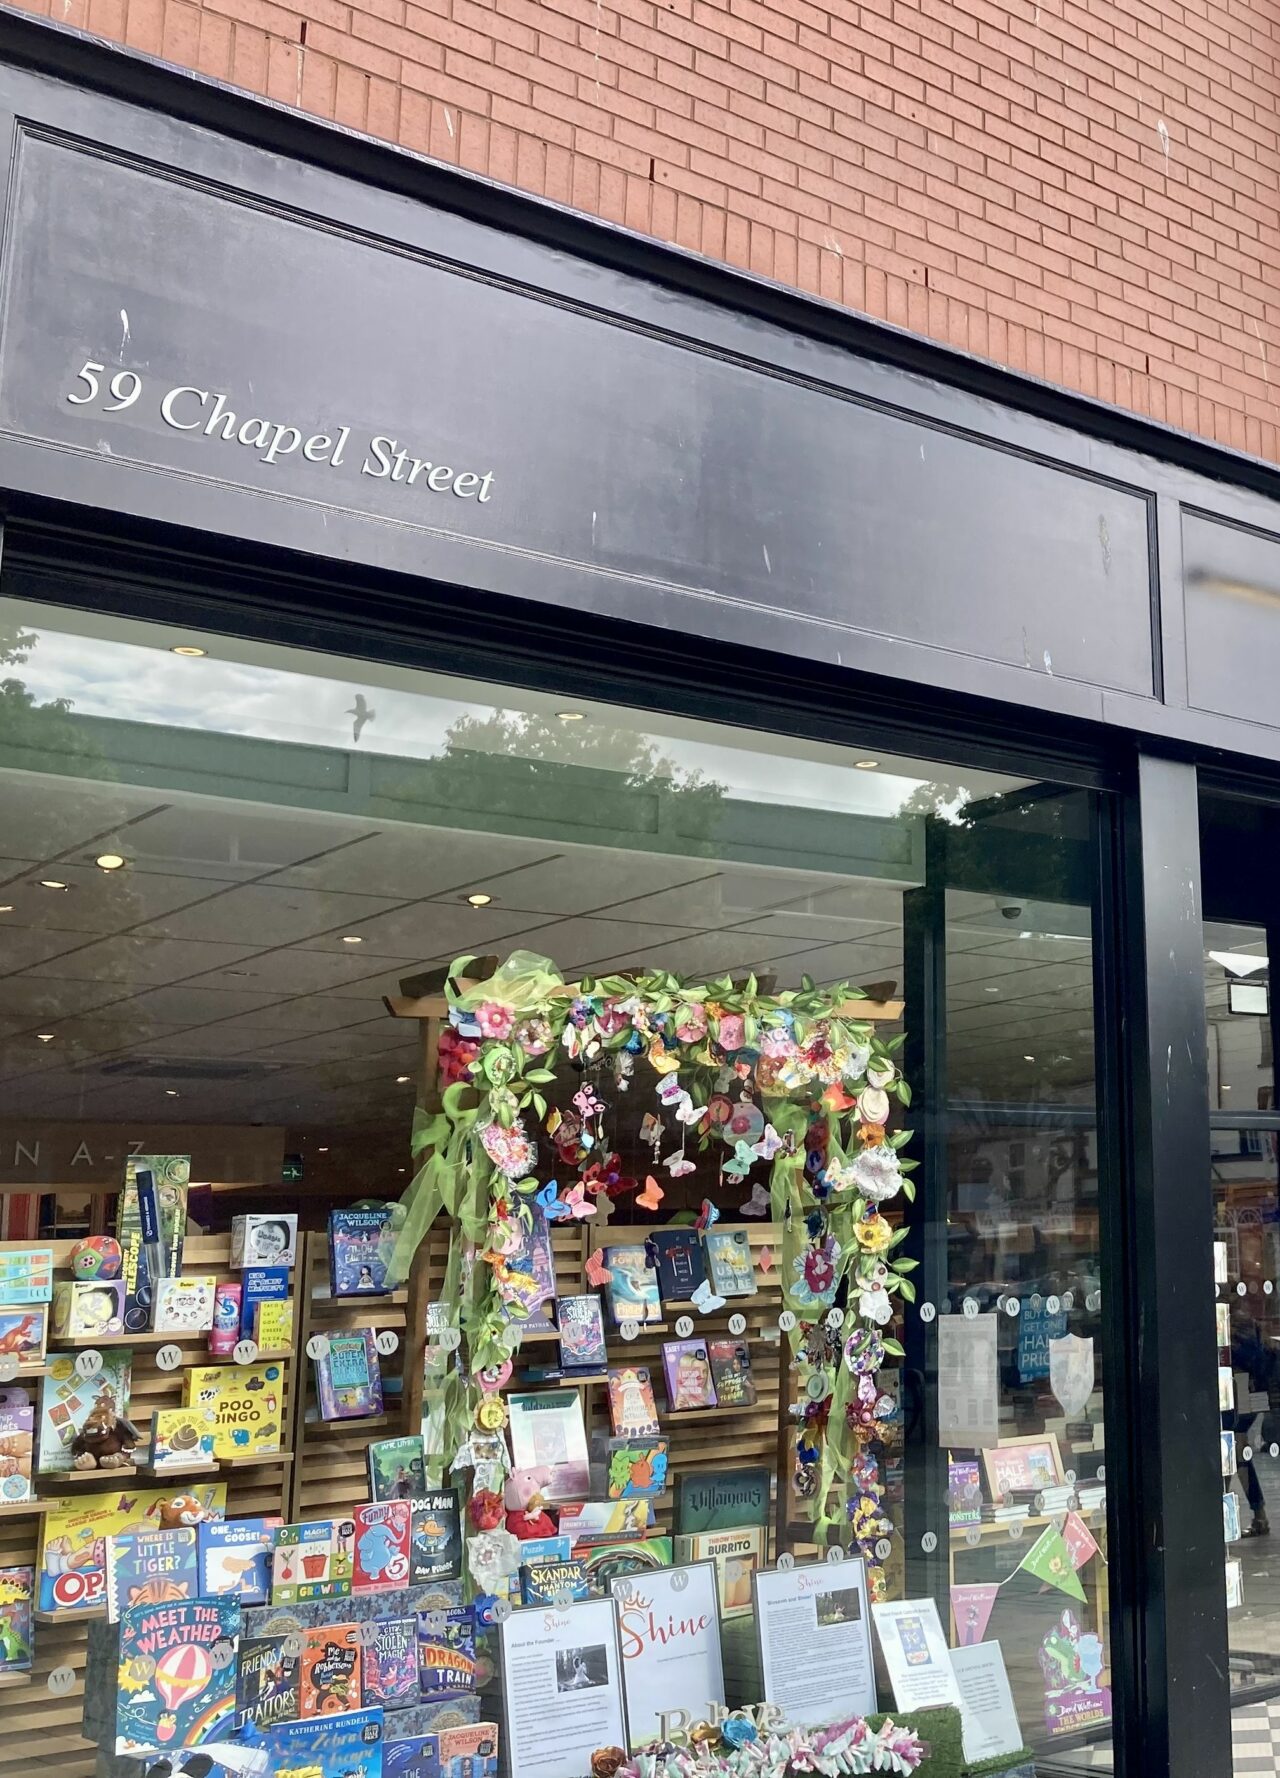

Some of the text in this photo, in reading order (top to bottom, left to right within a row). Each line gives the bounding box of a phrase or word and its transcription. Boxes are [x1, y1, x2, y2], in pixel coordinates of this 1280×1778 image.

[67, 360, 496, 503] 59 Chapel Street
[347, 1219, 380, 1227] WILSON
[126, 1232, 141, 1295] TELESCOPE
[716, 1264, 750, 1276] USED
[719, 1279, 753, 1291] TO BE
[1024, 1310, 1040, 1320] BUY
[1023, 1320, 1063, 1332] GET ONE
[220, 1399, 254, 1413] POO
[996, 1464, 1025, 1478] HALF
[411, 1496, 454, 1513] DOG MAN
[689, 1487, 761, 1512] Villainous
[361, 1505, 391, 1524] Funny
[137, 1532, 174, 1543] WHERE IS
[224, 1532, 260, 1543] GOOSE!
[303, 1527, 329, 1538] MAGIC
[708, 1535, 729, 1545] THROW
[137, 1542, 175, 1558] LITTLE
[522, 1545, 545, 1554] Puzzle
[708, 1540, 751, 1556] BURRITO
[132, 1556, 181, 1574] TIGER?
[388, 1557, 405, 1574] 5
[530, 1566, 583, 1586] SKANDAR
[299, 1581, 349, 1597] GROWING
[539, 1582, 577, 1593] PHANTOM
[141, 1606, 219, 1635] MEET THE
[544, 1614, 571, 1632] Shine
[383, 1625, 399, 1635] CITY
[620, 1611, 713, 1659] Shine
[375, 1634, 408, 1652] STOLEN
[241, 1647, 277, 1678] FRIENDS
[378, 1648, 406, 1664] MAGIC
[425, 1647, 475, 1674] DRAGON
[436, 1669, 472, 1685] TRAIN
[239, 1687, 296, 1727] TRAITORS
[289, 1715, 370, 1736] KATHERINE RUNDELL
[448, 1729, 490, 1742] JACQUELINE
[454, 1736, 484, 1746] WILSON
